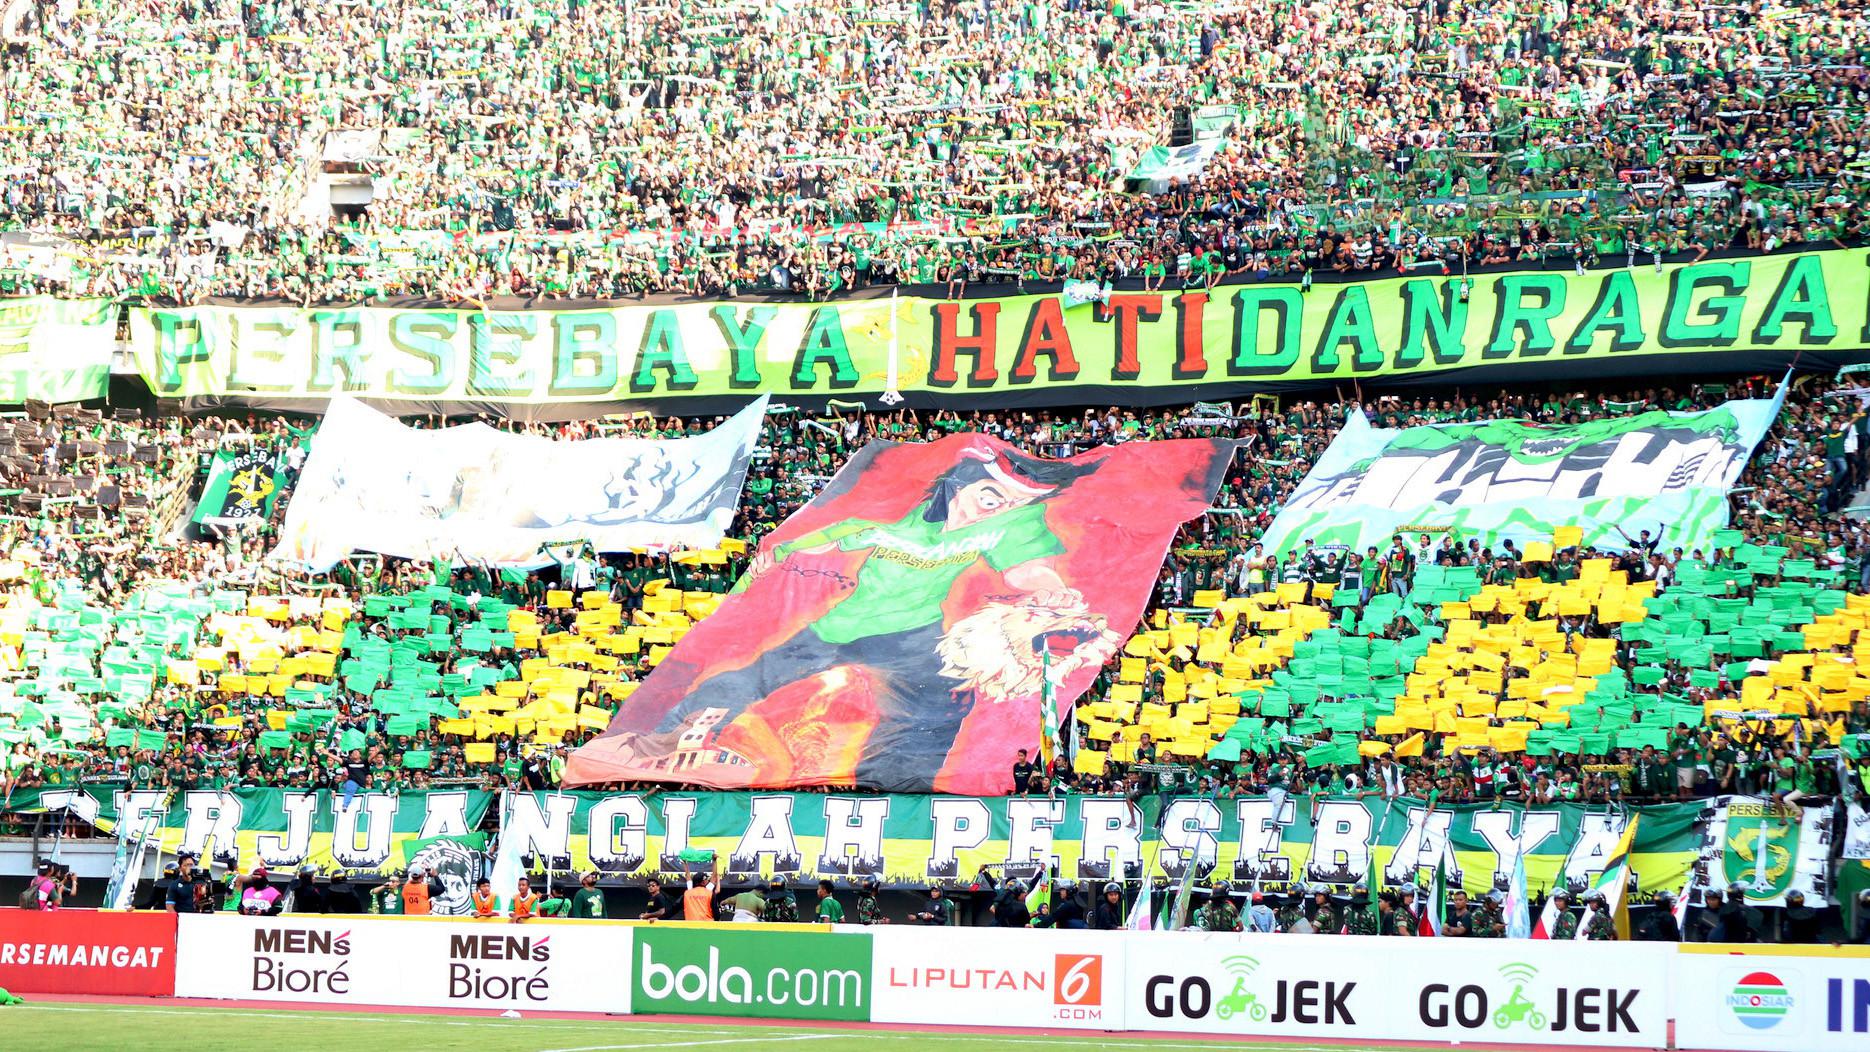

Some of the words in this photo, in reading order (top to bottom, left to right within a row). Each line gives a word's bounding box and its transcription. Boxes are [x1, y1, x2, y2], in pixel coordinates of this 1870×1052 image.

[152, 305, 860, 397] PERSEBAYA
[928, 293, 1209, 388] HATI
[926, 797, 1640, 893] PERSEBAYA
[0, 943, 164, 968] RSEMANGAT
[252, 956, 350, 994] Bioré
[641, 942, 862, 1008] bola.com
[449, 963, 549, 1001] Bioré
[889, 967, 1046, 991] LIPUTAN
[1061, 957, 1096, 1004] 6
[1145, 975, 1212, 1019] GO
[1271, 981, 1357, 1025] JEK
[1726, 994, 1795, 1008] INDOSIAR
[1418, 984, 1488, 1029] GO
[1550, 988, 1641, 1033] JEK
